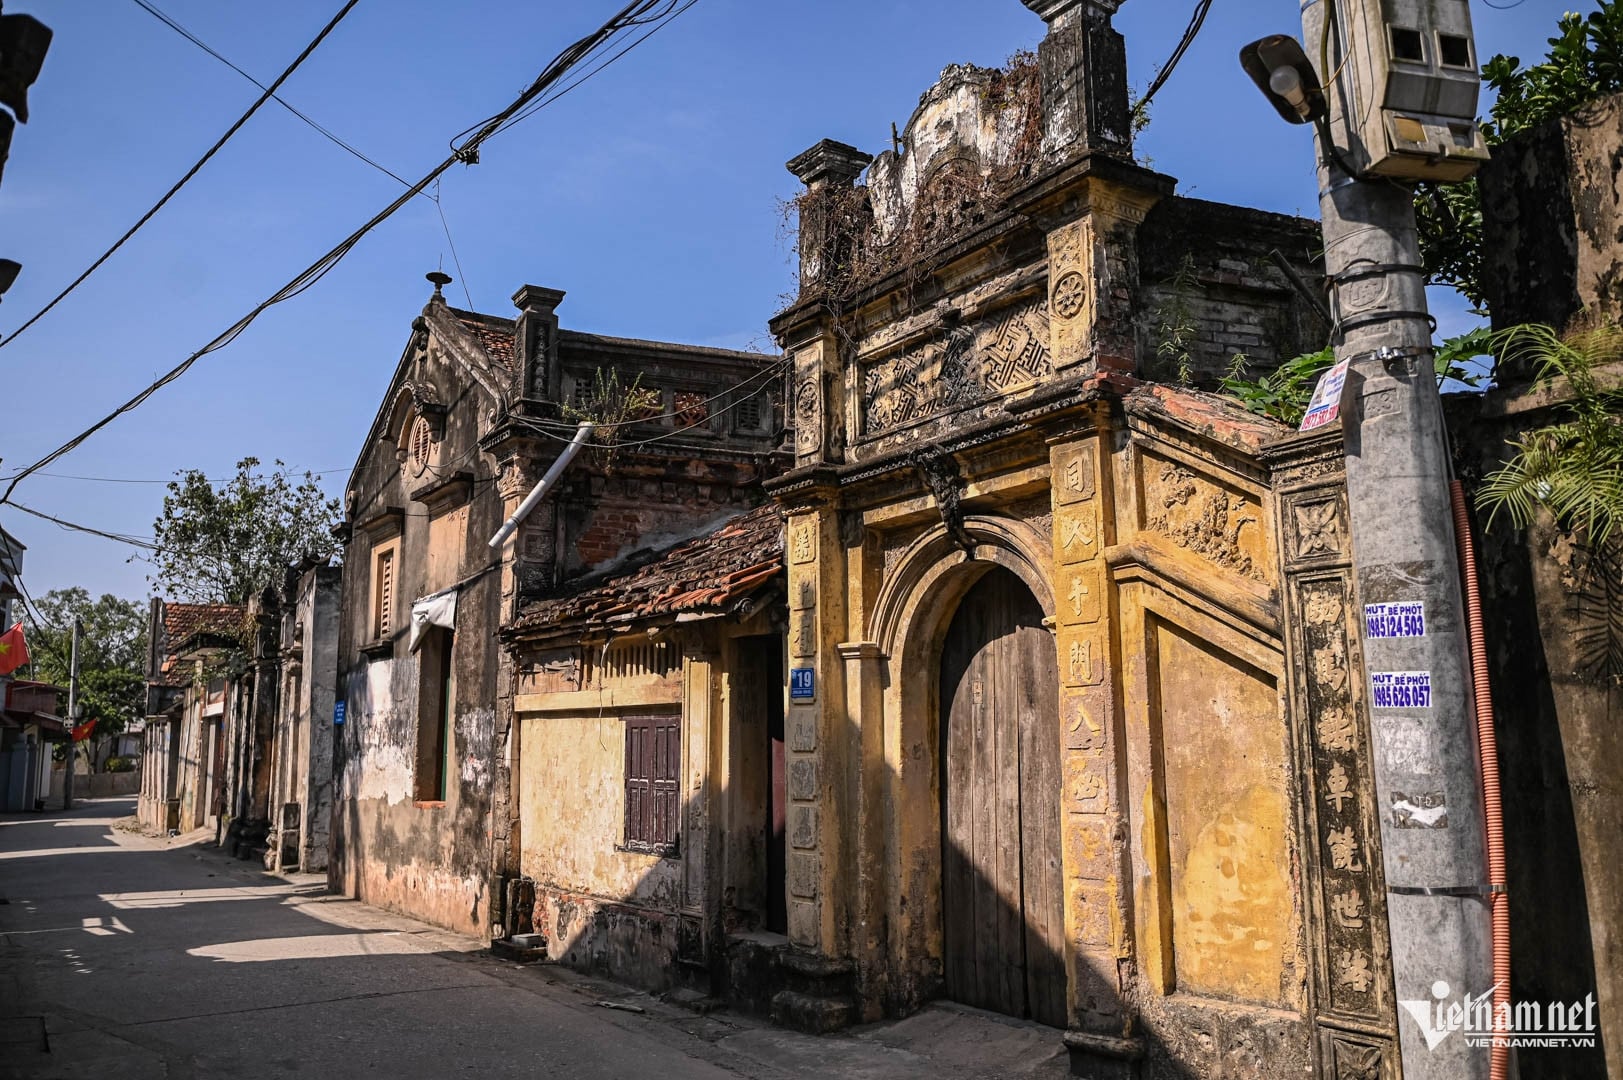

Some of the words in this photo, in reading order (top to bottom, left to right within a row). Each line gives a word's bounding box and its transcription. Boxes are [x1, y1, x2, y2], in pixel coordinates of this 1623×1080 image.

[1366, 604, 1386, 614] HÚT
[1400, 603, 1422, 615] PHỐT
[797, 671, 811, 688] 19
[1373, 673, 1392, 683] HÚT
[1407, 673, 1429, 685] PHỐT
